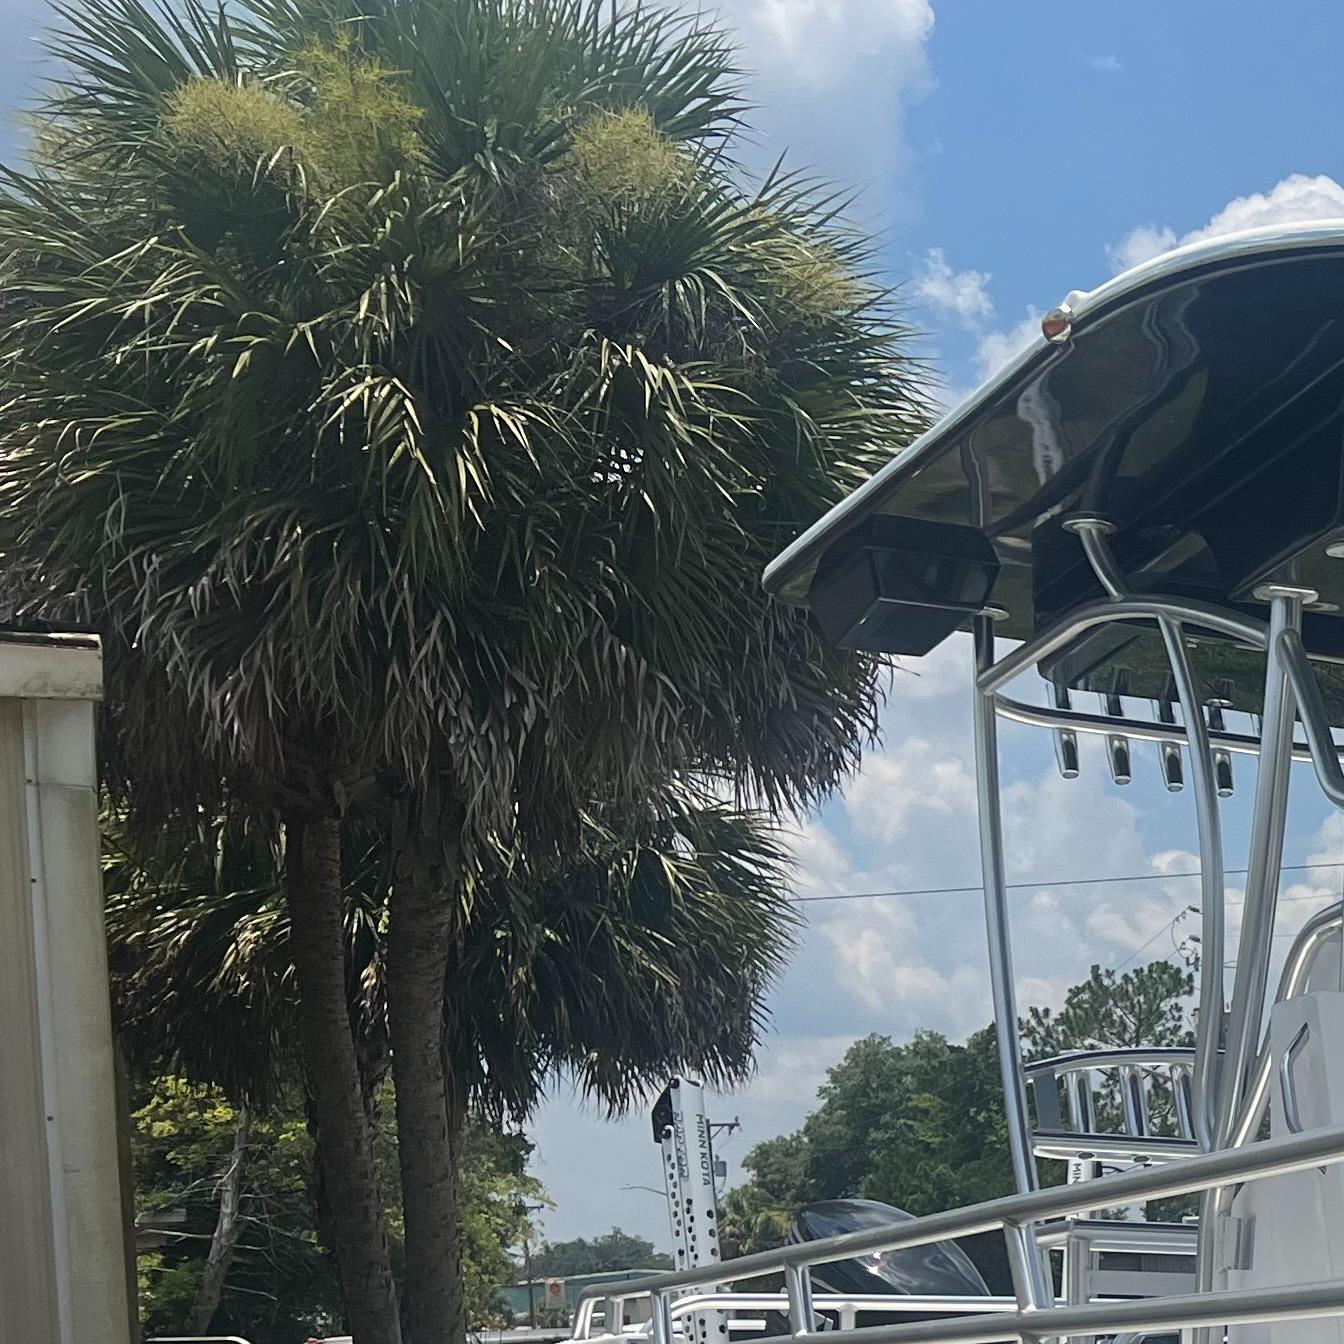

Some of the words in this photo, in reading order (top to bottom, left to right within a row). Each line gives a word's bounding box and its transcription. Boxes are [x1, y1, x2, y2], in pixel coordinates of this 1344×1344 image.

[696, 1113, 707, 1149] MINN
[700, 1151, 711, 1186] KOTA
[1072, 1163, 1082, 1184] MIN
